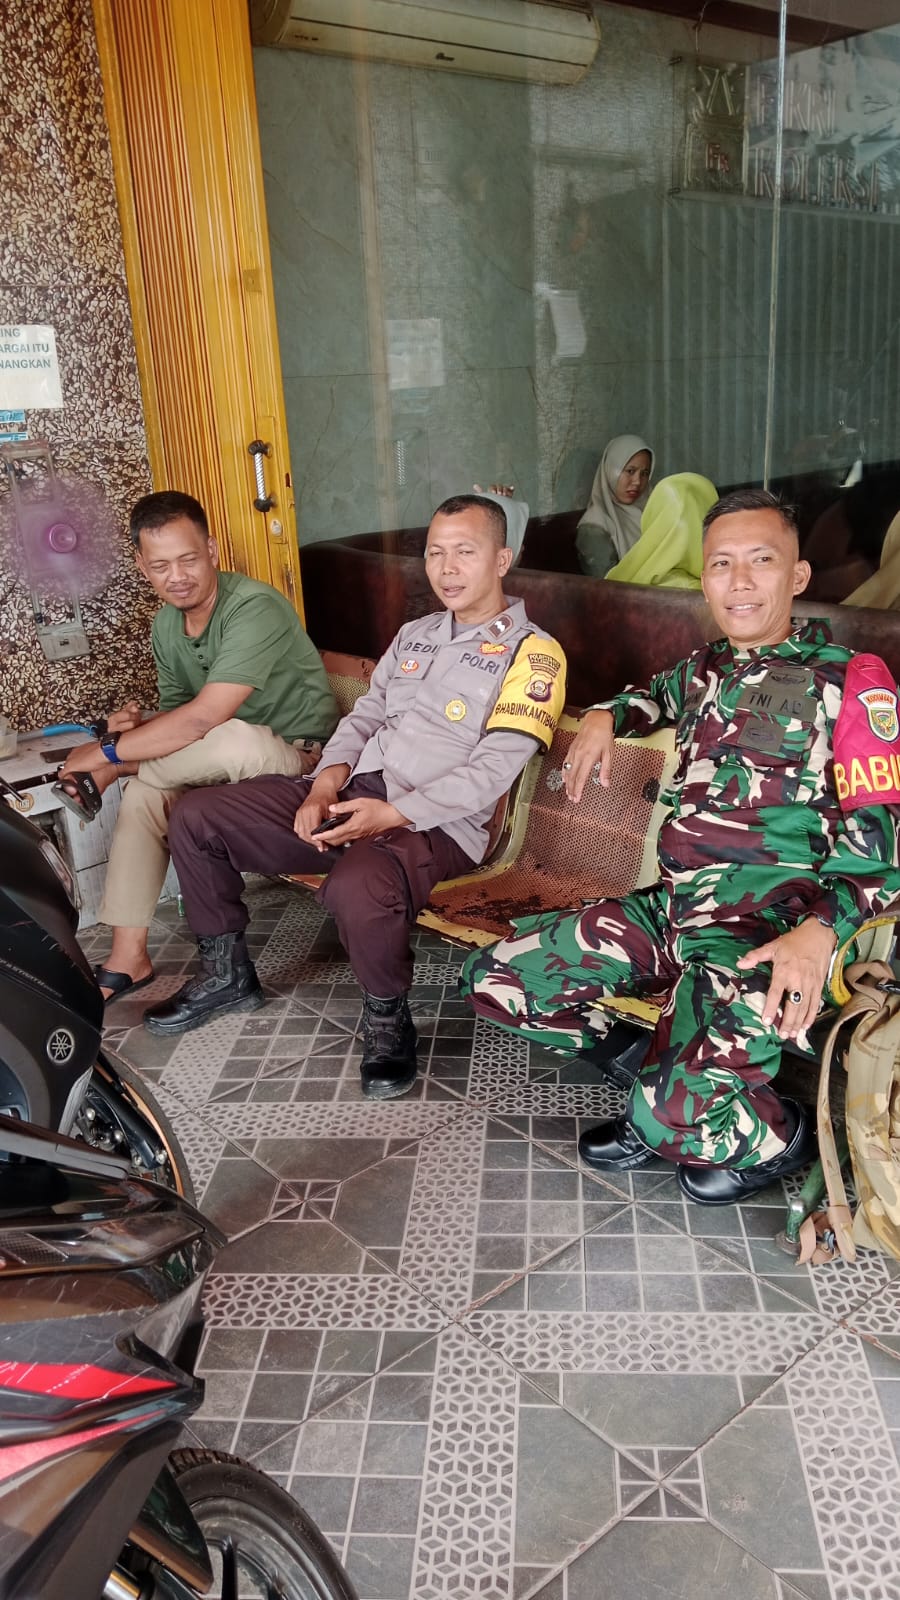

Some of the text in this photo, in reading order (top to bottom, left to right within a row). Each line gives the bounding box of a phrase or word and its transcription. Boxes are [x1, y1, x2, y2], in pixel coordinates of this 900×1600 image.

[32, 343, 50, 353] ITU
[403, 642, 439, 654] DEDI
[459, 652, 500, 675] POLRI
[749, 691, 773, 708] TNI
